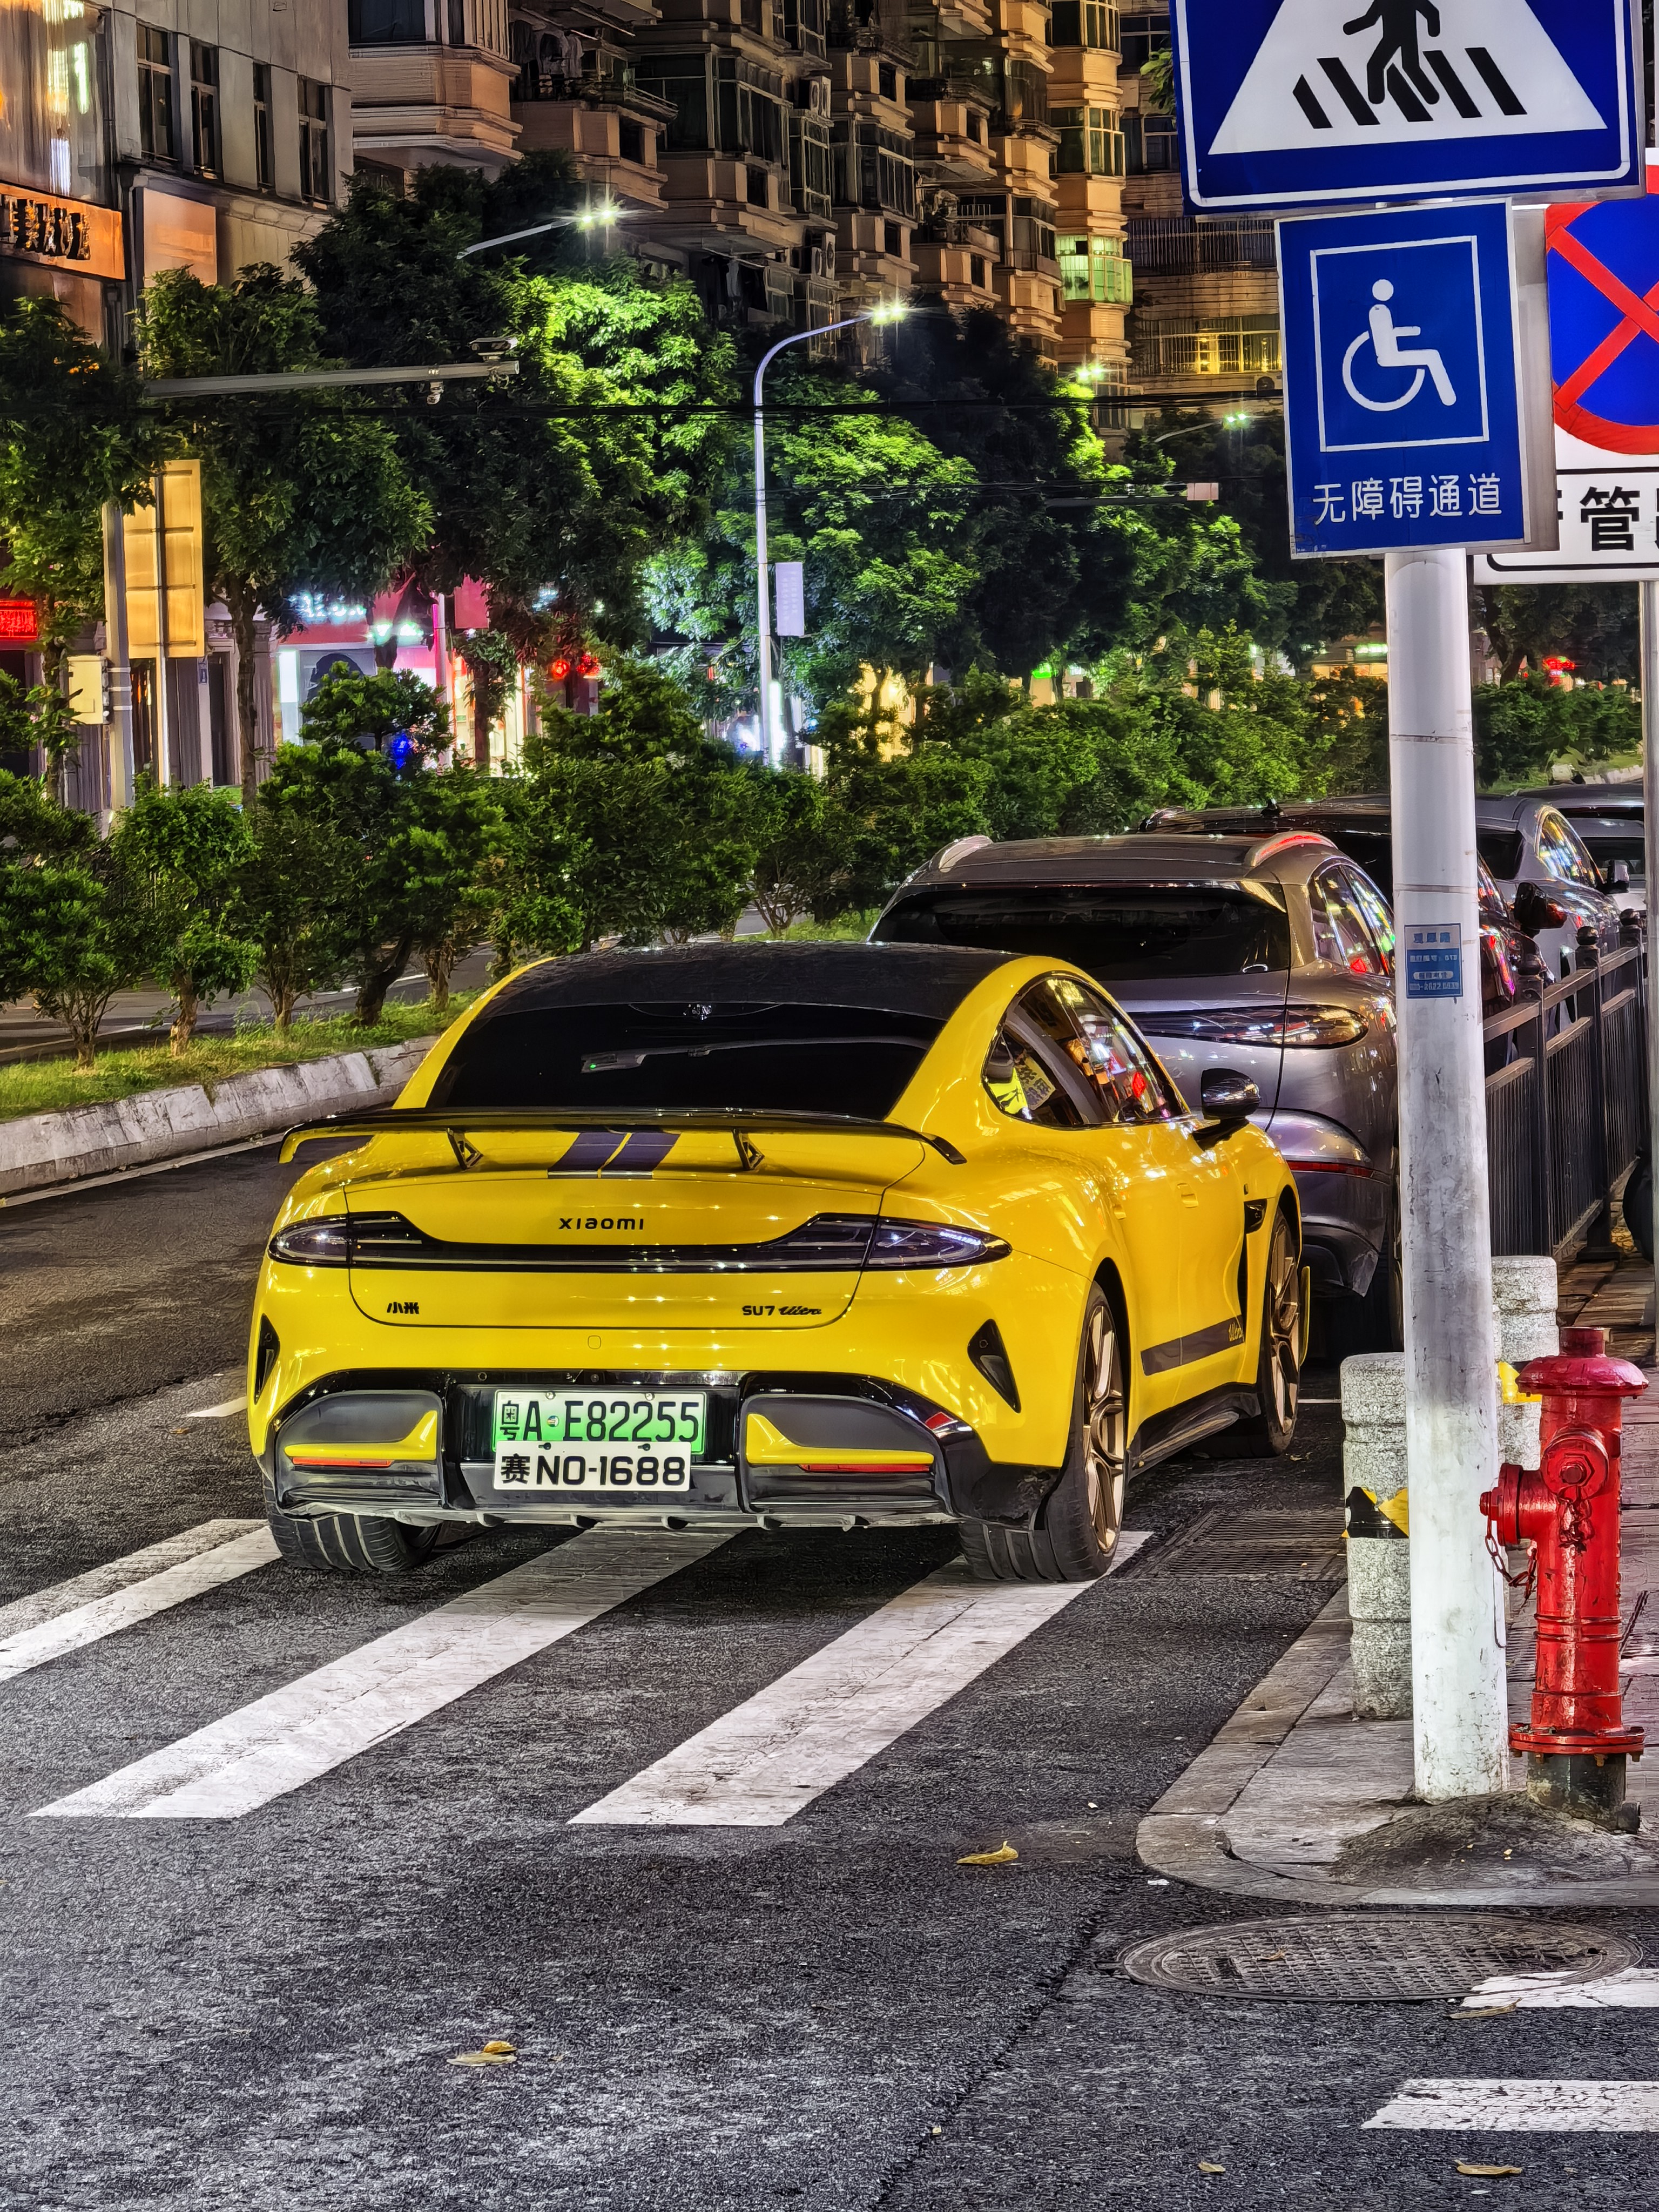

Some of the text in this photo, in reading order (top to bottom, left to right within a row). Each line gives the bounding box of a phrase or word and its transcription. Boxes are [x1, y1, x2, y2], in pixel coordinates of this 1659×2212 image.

[1313, 473, 1502, 525] 无障碍通道
[558, 1218, 644, 1230] xiaomi
[387, 1301, 420, 1314] 小米
[742, 1305, 822, 1316] SU7 Ultra
